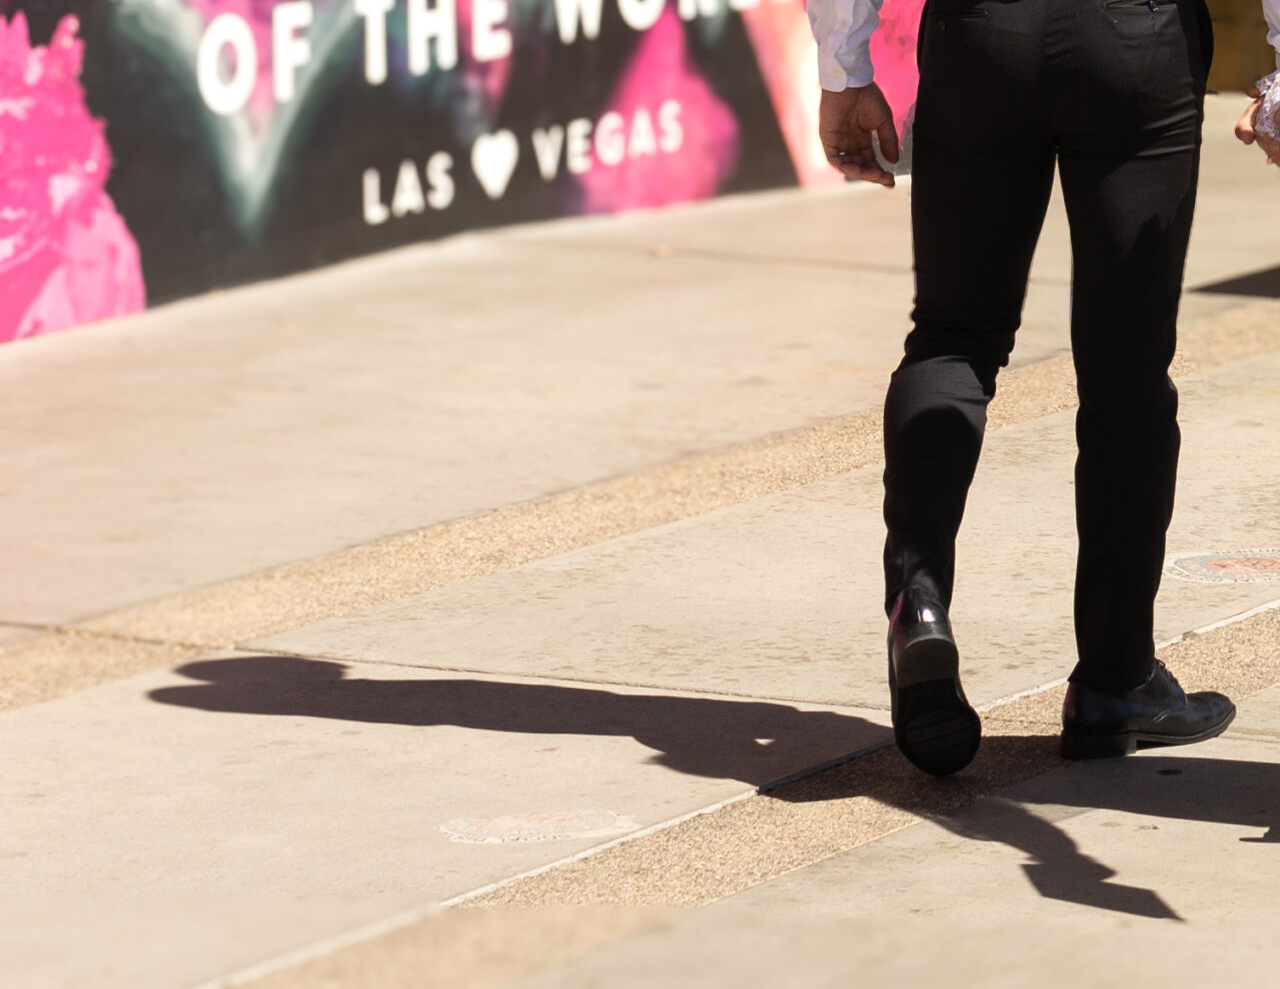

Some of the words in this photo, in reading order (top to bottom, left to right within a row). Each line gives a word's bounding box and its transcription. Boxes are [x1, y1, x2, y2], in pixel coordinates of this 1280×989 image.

[197, 0, 313, 116] OF
[362, 152, 455, 226] LAS
[533, 101, 684, 182] VEGAS
